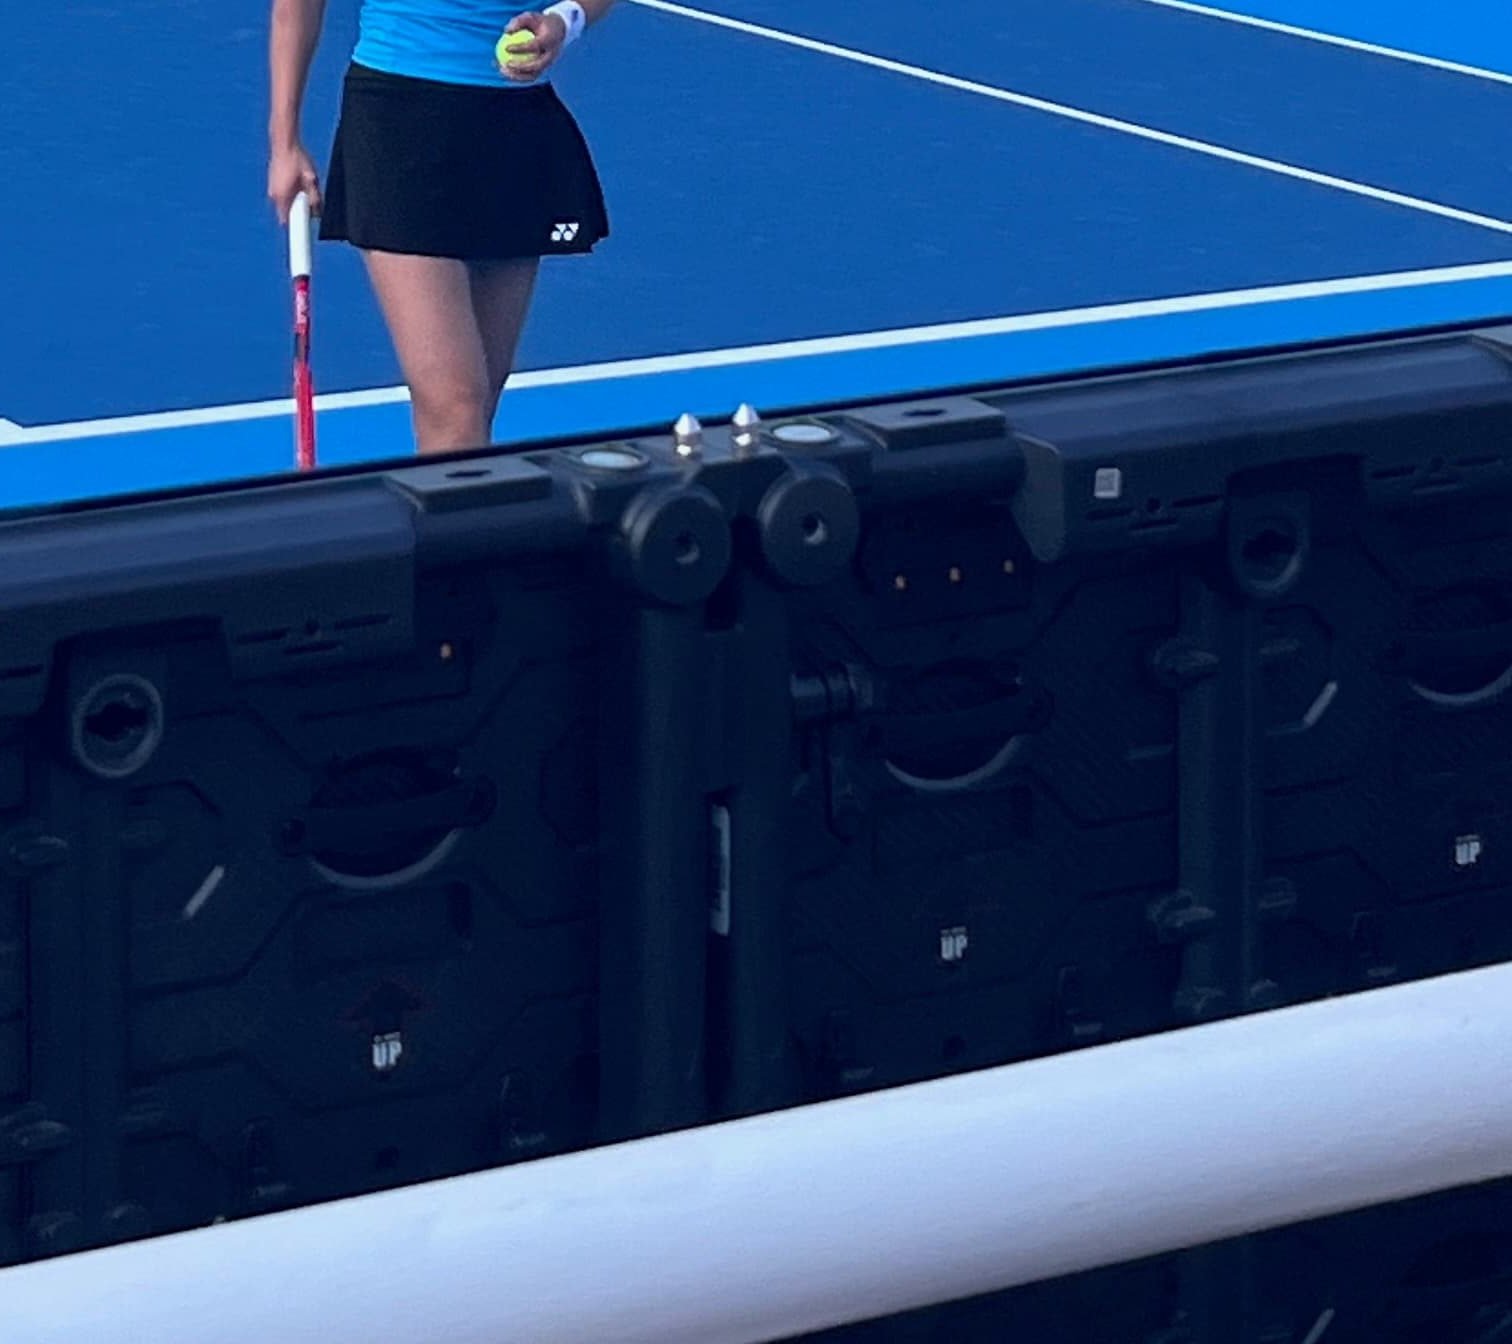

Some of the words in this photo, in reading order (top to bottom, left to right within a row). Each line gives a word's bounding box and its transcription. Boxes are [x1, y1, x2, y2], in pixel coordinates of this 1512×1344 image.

[1455, 841, 1481, 865] UP
[940, 934, 969, 961] UP
[372, 1041, 402, 1069] UP
